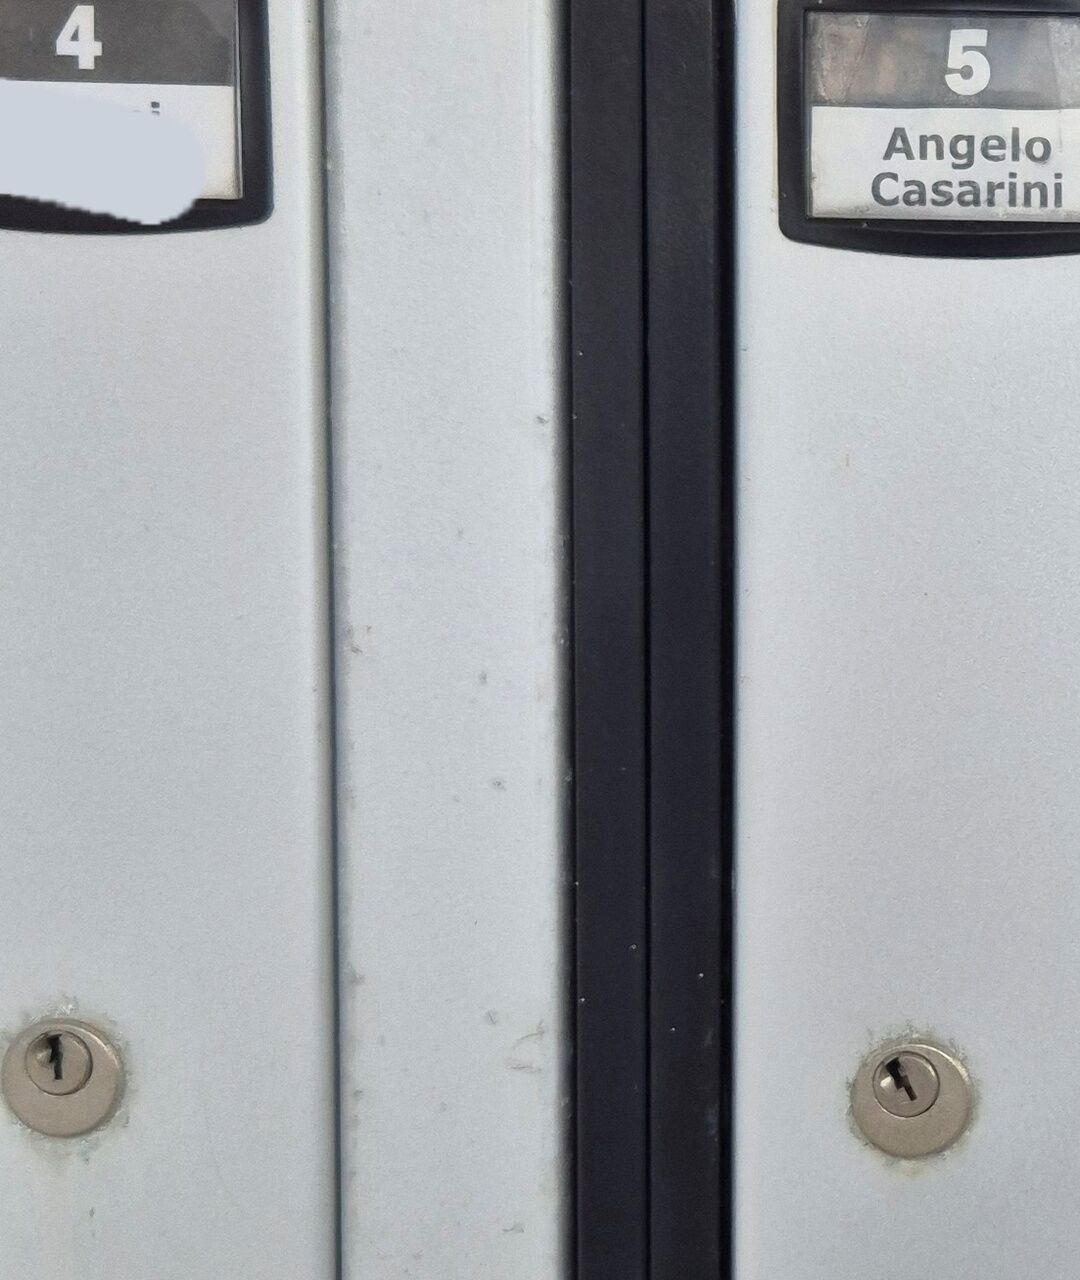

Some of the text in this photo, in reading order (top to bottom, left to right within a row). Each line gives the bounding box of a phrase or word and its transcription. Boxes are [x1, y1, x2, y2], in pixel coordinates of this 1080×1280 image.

[55, 4, 103, 70] 4
[944, 28, 992, 97] 5
[882, 126, 1053, 171] Angelo
[870, 172, 1064, 210] Casarini
